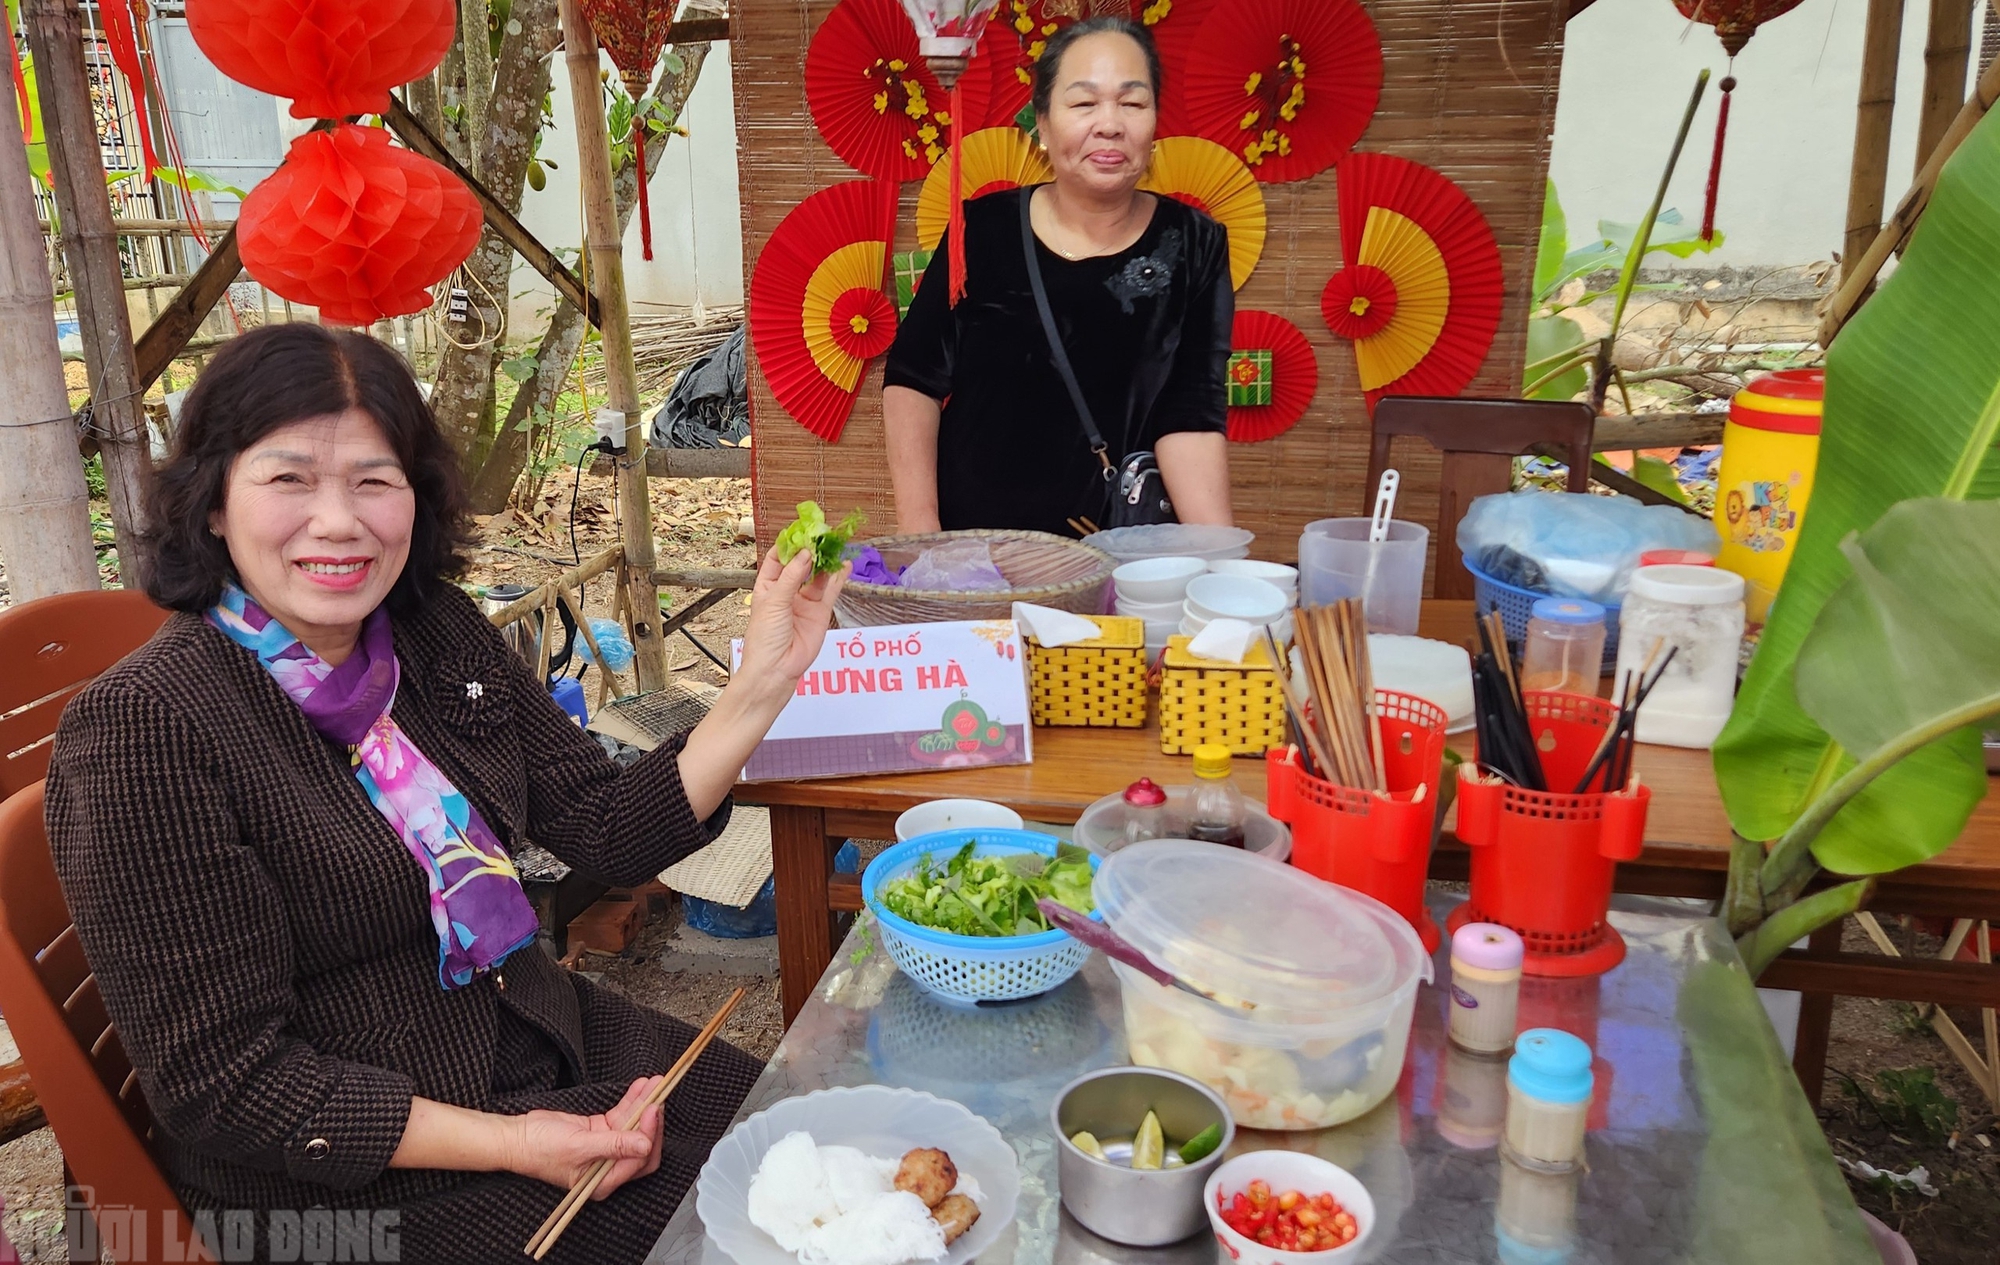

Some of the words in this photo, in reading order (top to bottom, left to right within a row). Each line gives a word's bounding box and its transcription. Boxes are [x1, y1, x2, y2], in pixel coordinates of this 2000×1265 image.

[836, 630, 866, 658] TỔ
[874, 631, 923, 657] PHỐ
[796, 666, 903, 696] HƯNG
[917, 659, 969, 690] HÀ
